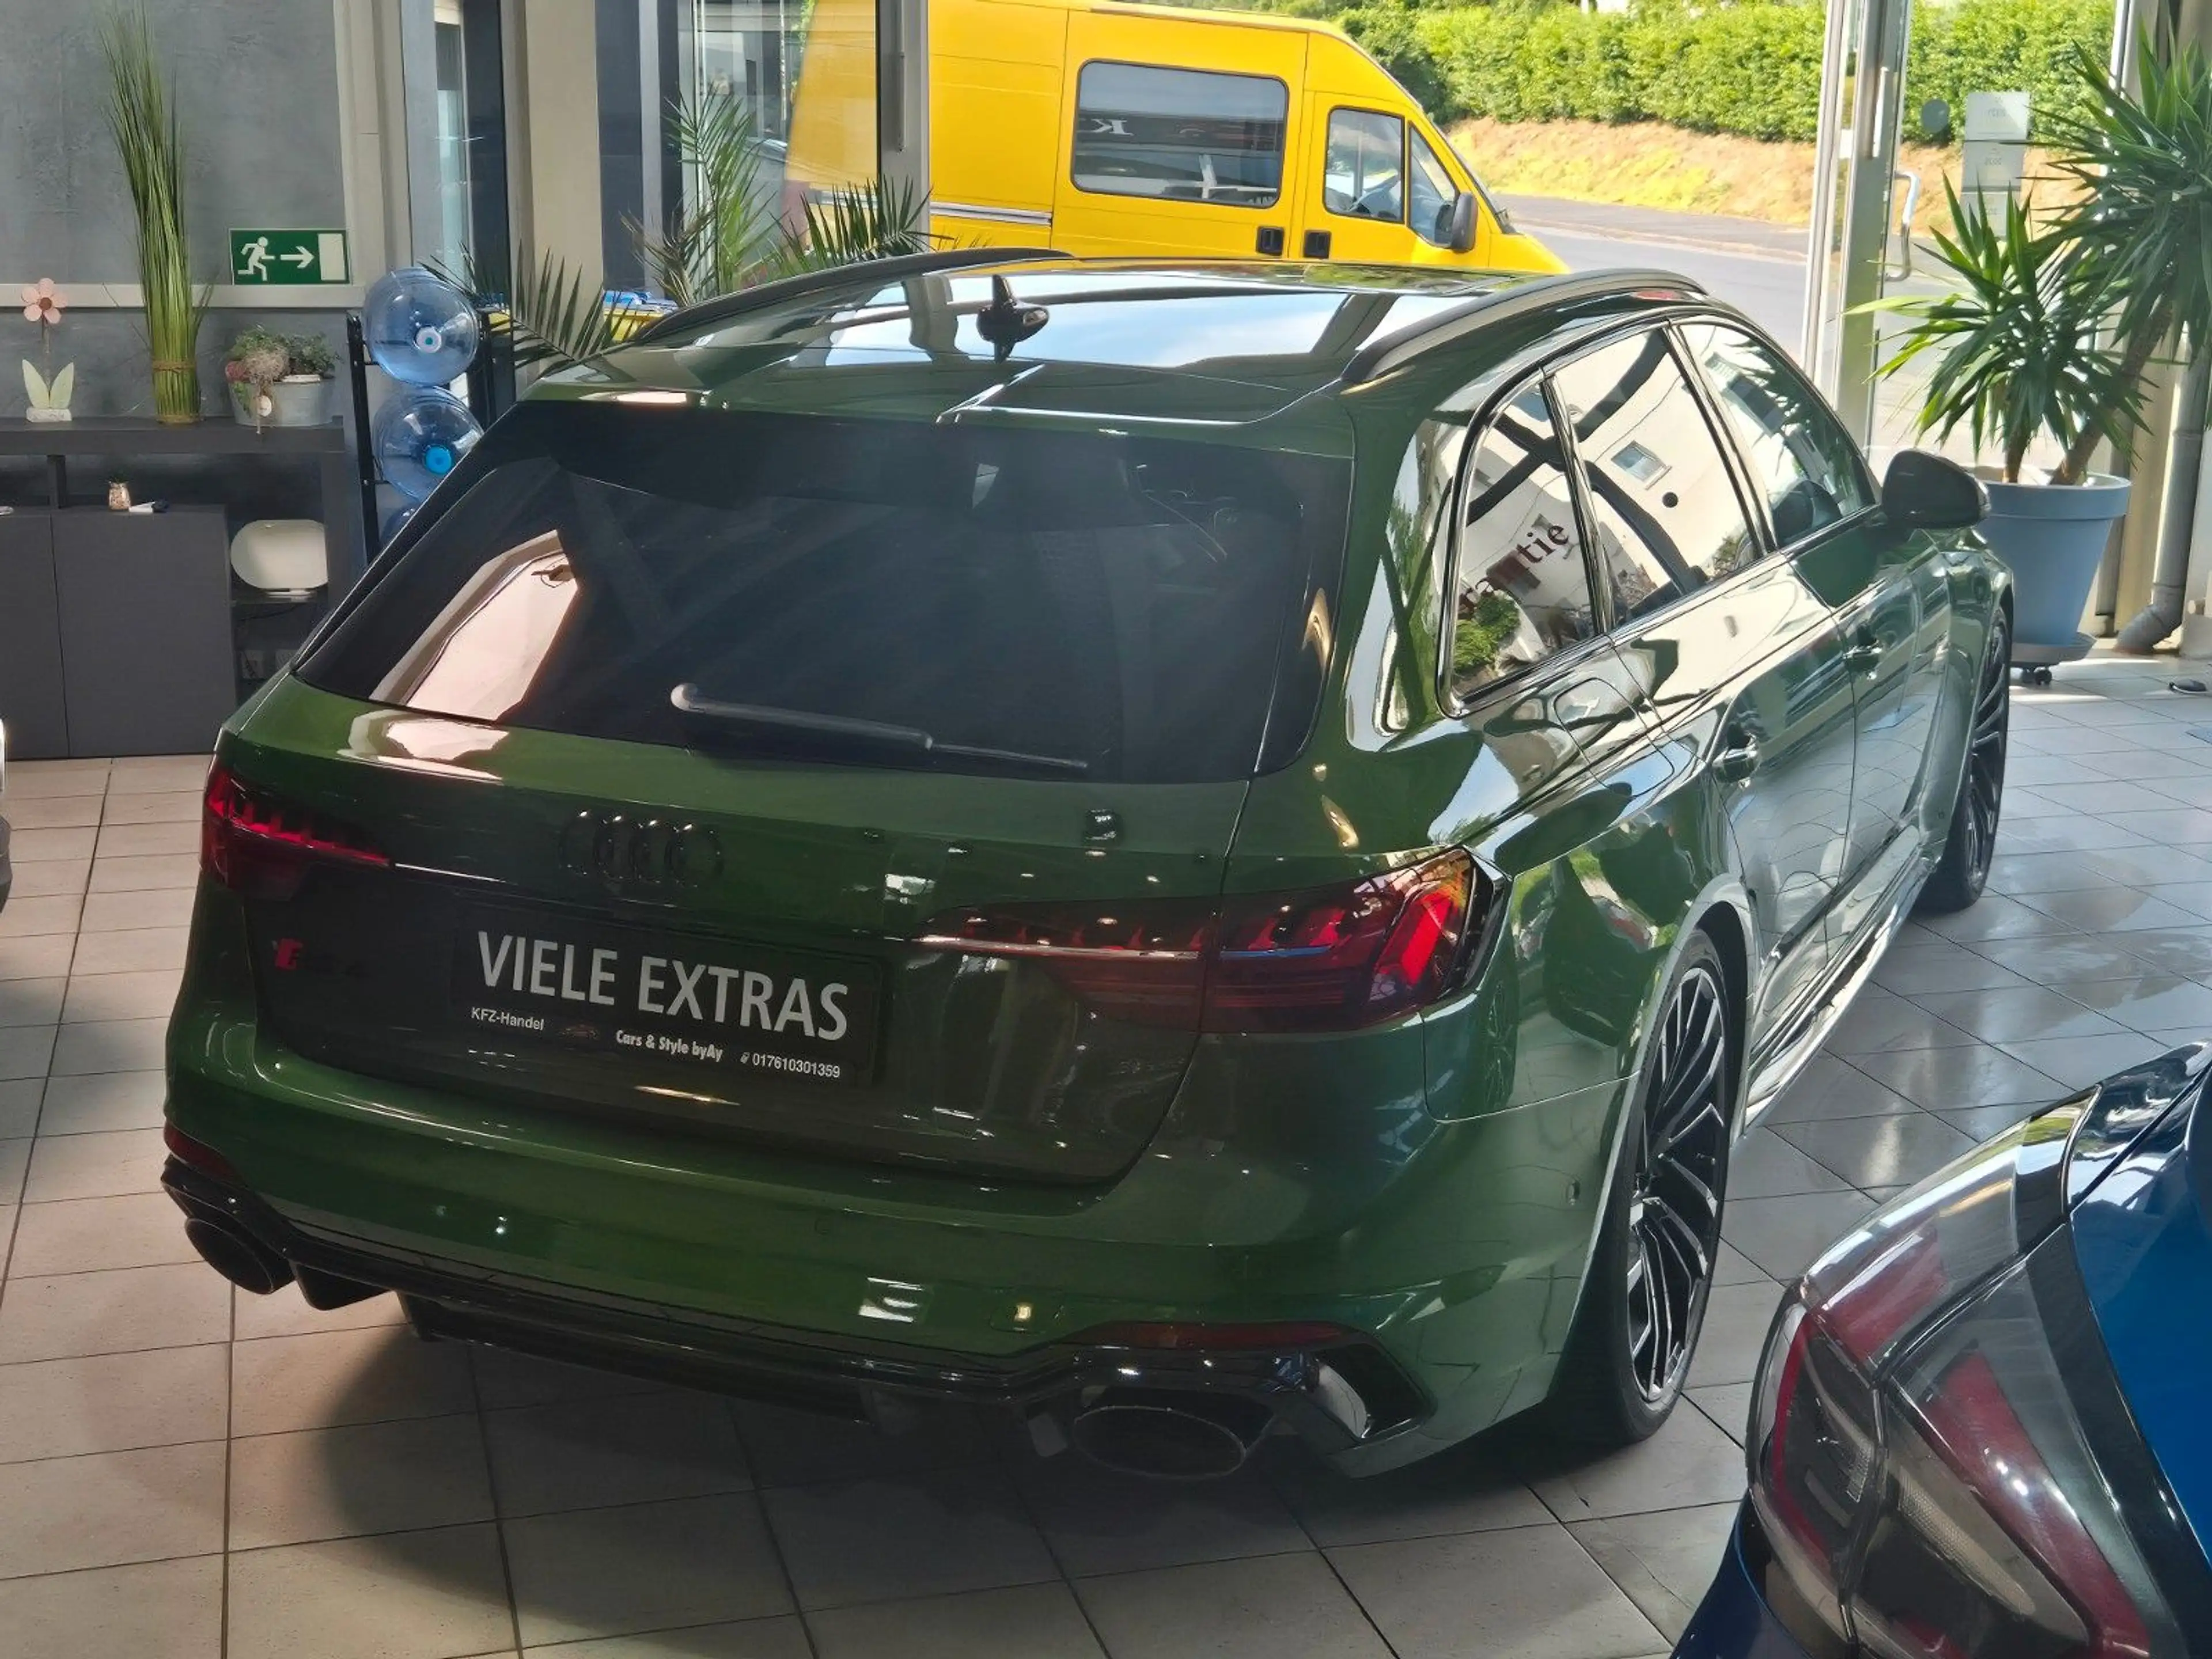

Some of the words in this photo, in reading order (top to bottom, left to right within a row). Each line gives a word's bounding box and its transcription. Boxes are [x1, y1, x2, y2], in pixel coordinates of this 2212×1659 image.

[1459, 525, 1569, 619] ratie
[478, 930, 618, 1006] VIELE
[638, 956, 849, 1041] EXTRAS
[471, 1006, 545, 1031] KFZ-Handel
[616, 1029, 643, 1047] Cars
[645, 1034, 656, 1050] &
[658, 1036, 690, 1055] Style
[692, 1040, 724, 1063] byAy
[752, 1052, 841, 1078] 017610301359
